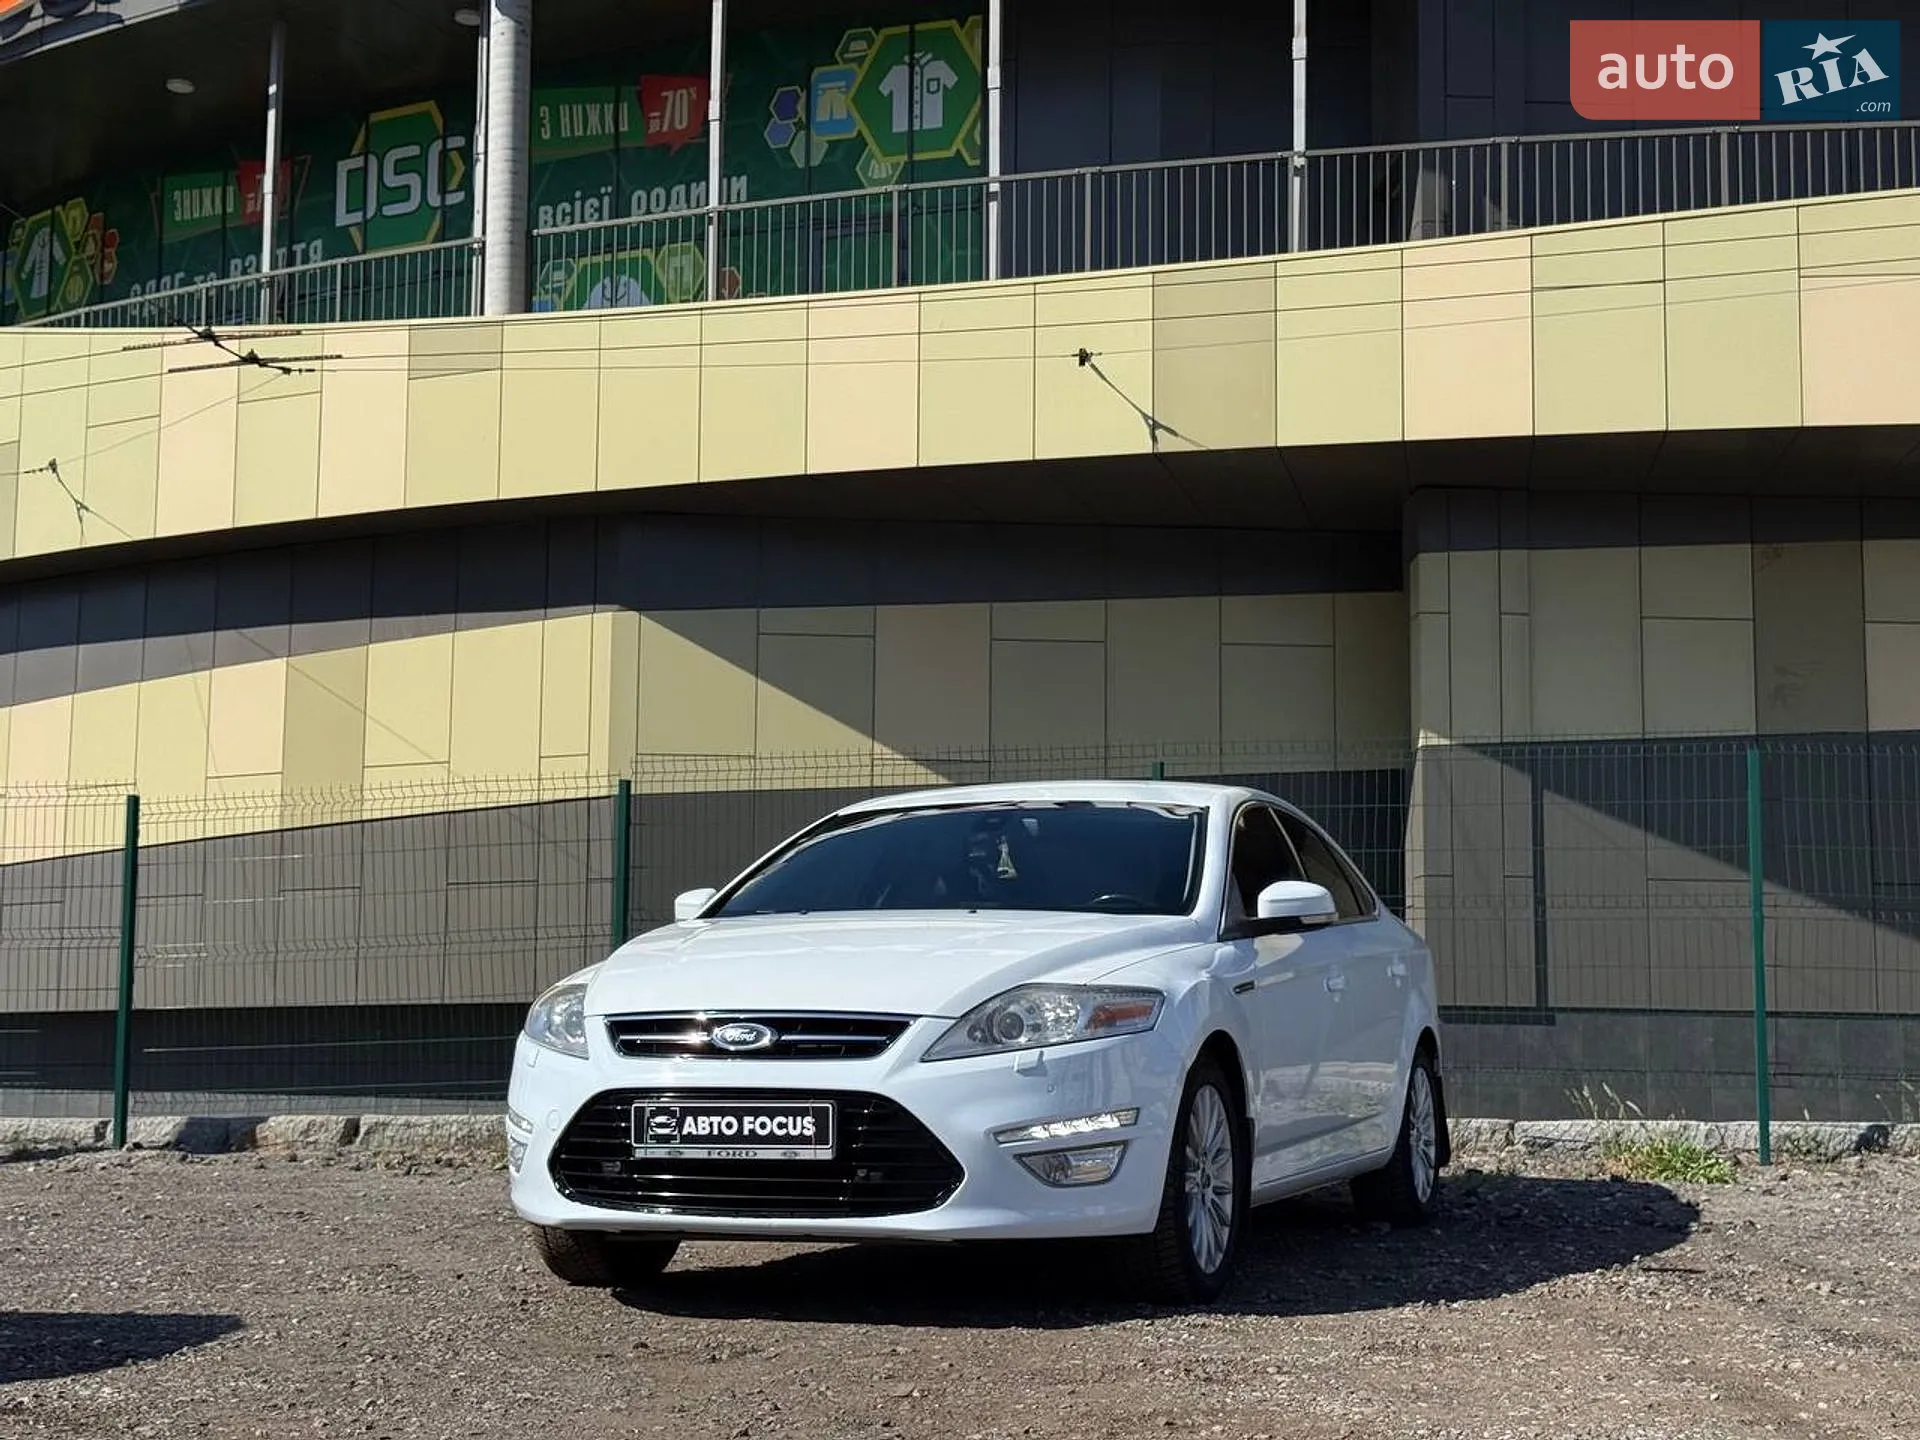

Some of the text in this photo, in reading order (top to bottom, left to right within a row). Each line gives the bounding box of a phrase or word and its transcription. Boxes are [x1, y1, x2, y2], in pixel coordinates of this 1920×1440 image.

[335, 135, 466, 228] DSC
[725, 1027, 757, 1042] Ford
[743, 1116, 816, 1136] FOCUS
[706, 1150, 758, 1158] FORD
